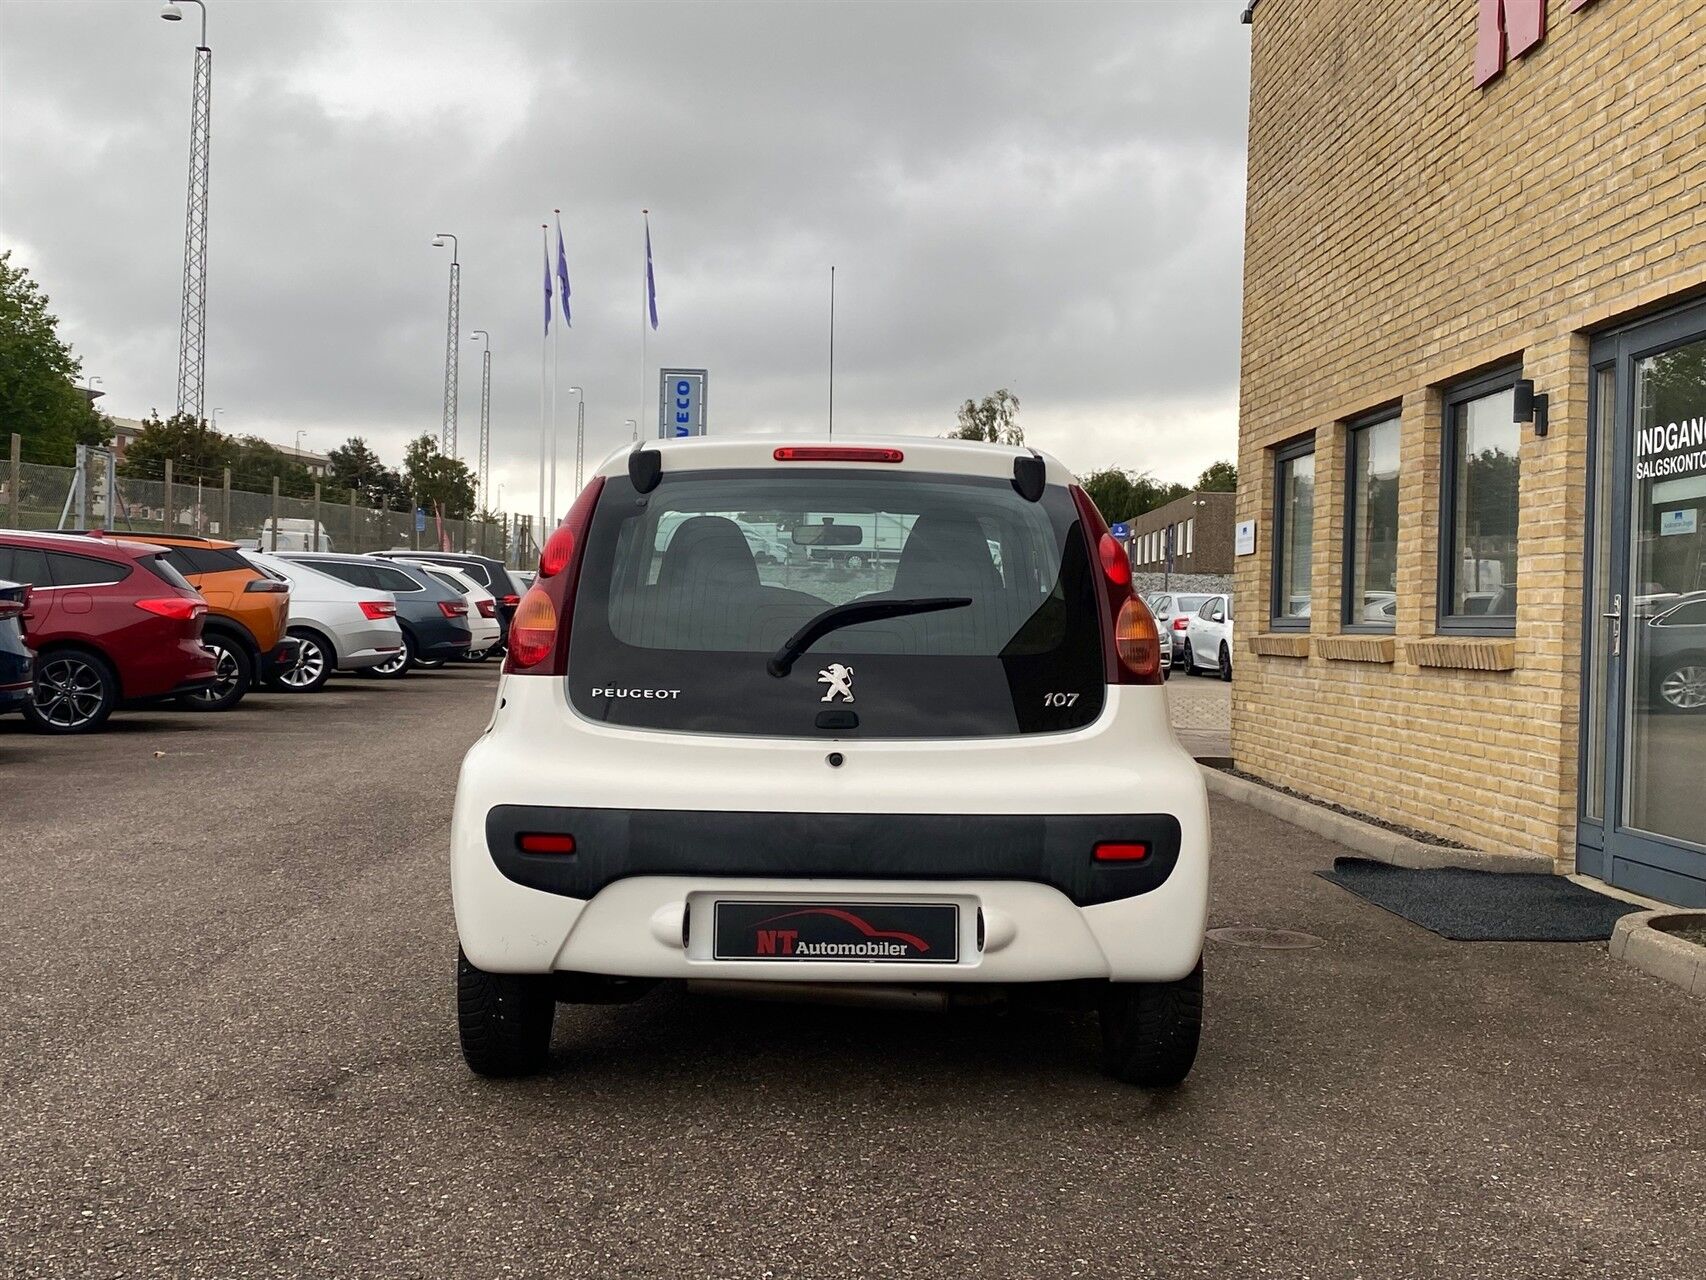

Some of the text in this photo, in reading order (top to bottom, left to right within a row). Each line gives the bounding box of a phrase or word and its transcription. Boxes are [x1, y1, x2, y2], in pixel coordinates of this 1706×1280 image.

[1637, 416, 1706, 456] INDGAN
[592, 688, 680, 699] PEUGEOT
[1044, 692, 1080, 707] 107
[757, 930, 908, 956] NT Automobiler
